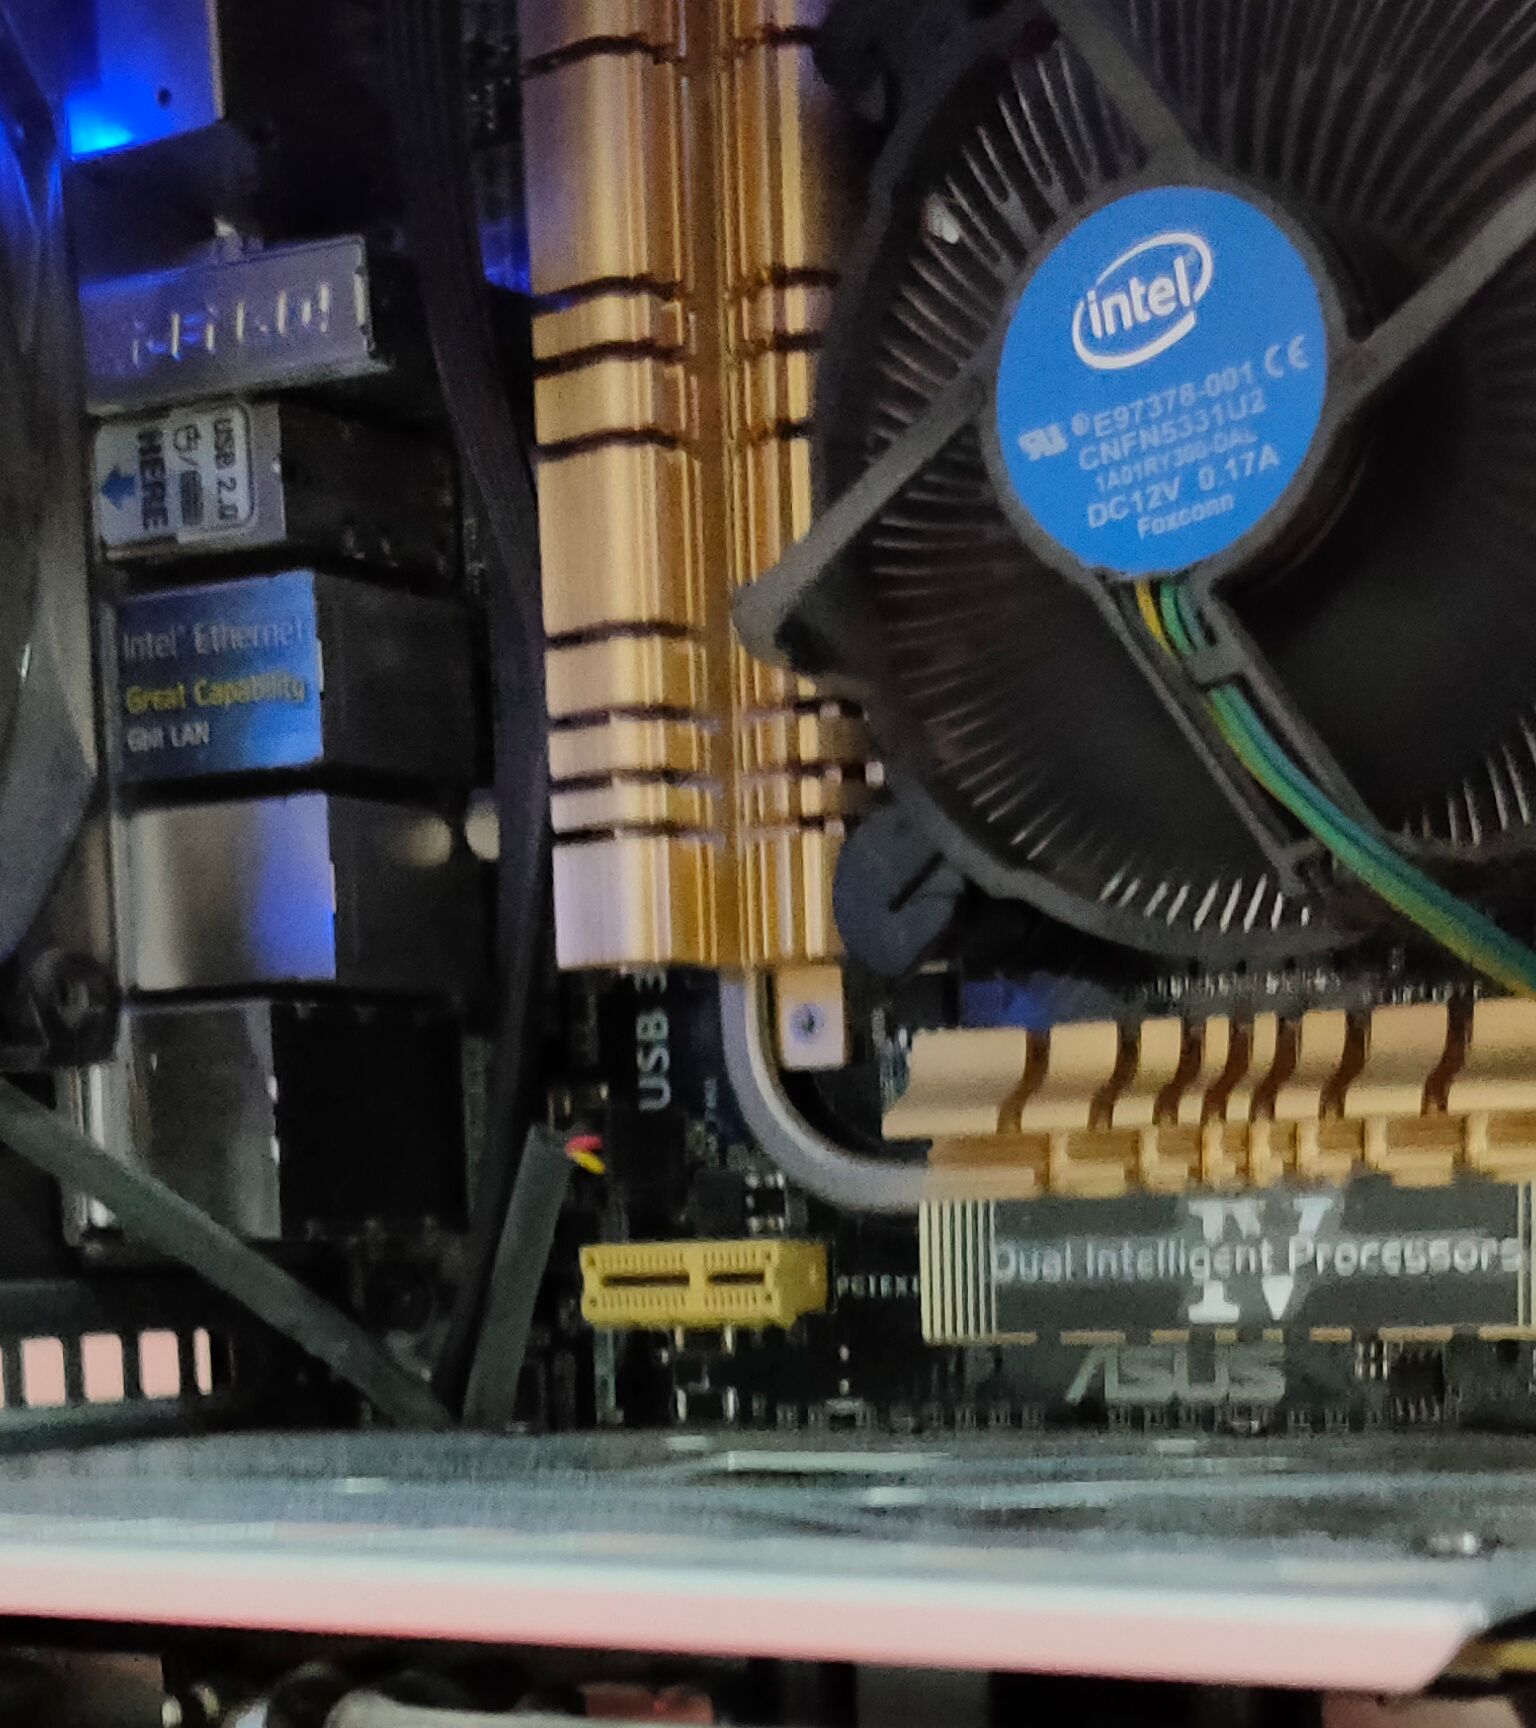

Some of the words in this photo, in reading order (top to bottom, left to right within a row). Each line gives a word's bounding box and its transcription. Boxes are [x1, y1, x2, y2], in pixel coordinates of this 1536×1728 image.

[1087, 255, 1191, 339] intel
[1087, 475, 1183, 529] DC12V
[1198, 444, 1281, 492] 0.17A
[1136, 494, 1236, 540] Foxconn
[636, 1009, 671, 1112] USB
[993, 1241, 1073, 1284] Dual
[1086, 1236, 1274, 1286] Intelligent
[1289, 1234, 1523, 1276] Processors
[1064, 1343, 1287, 1404] ASUS
